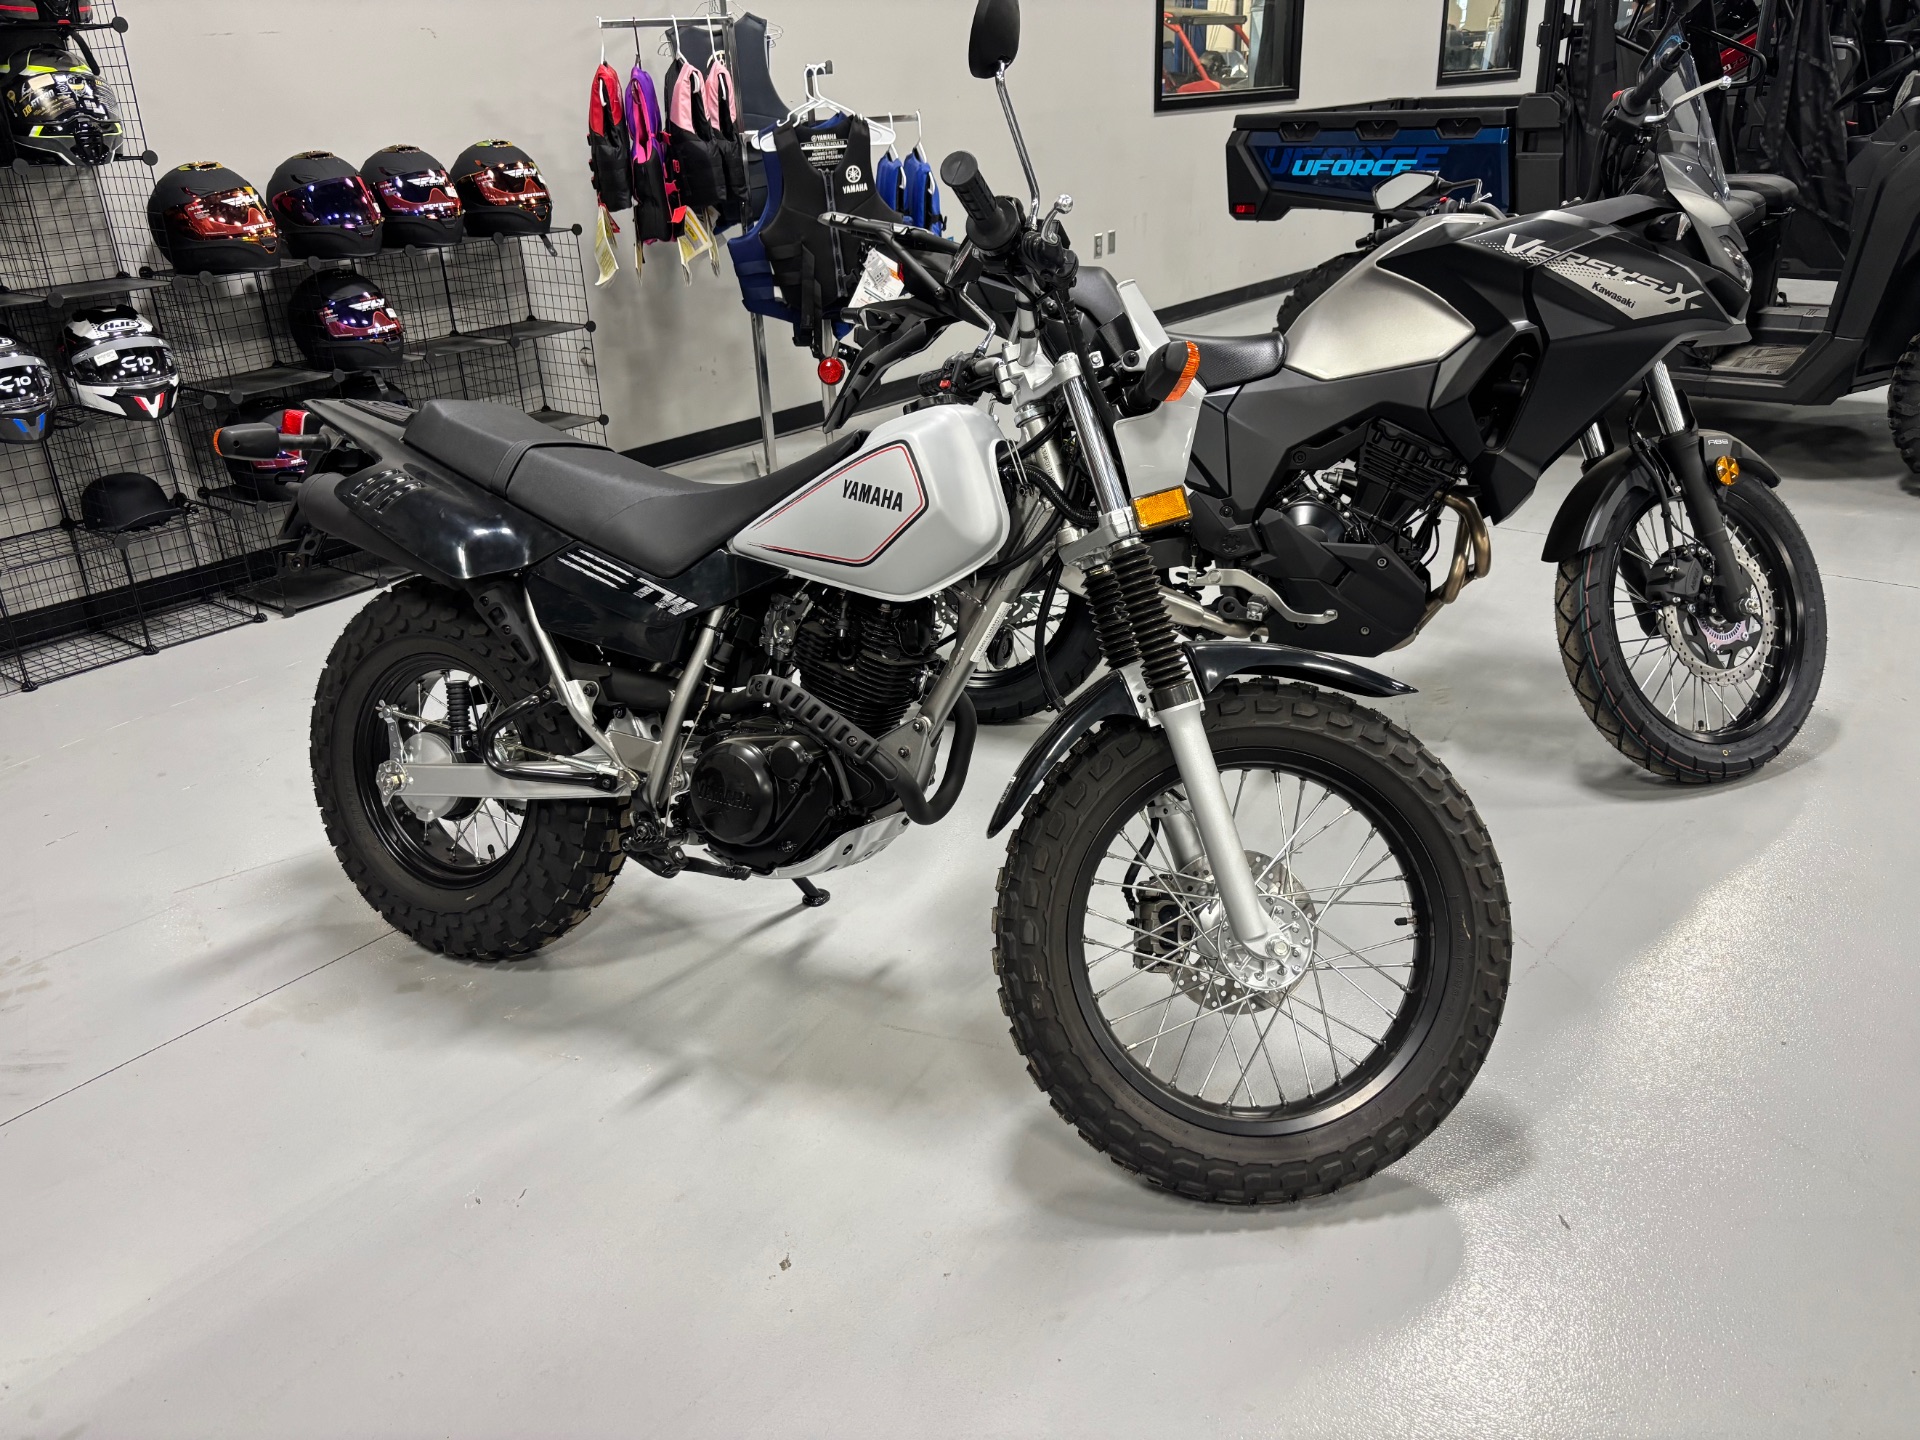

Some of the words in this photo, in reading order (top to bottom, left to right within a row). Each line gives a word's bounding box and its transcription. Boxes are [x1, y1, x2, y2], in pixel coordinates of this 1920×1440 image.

[816, 133, 837, 141] YAMAHA
[1291, 159, 1418, 176] UFORCE
[842, 182, 868, 194] YAMAHA
[1591, 281, 1637, 309] Kawasaki
[104, 320, 137, 331] HJC
[121, 355, 154, 369] C10
[1707, 438, 1729, 446] ABS
[842, 479, 903, 512] YAMAHA
